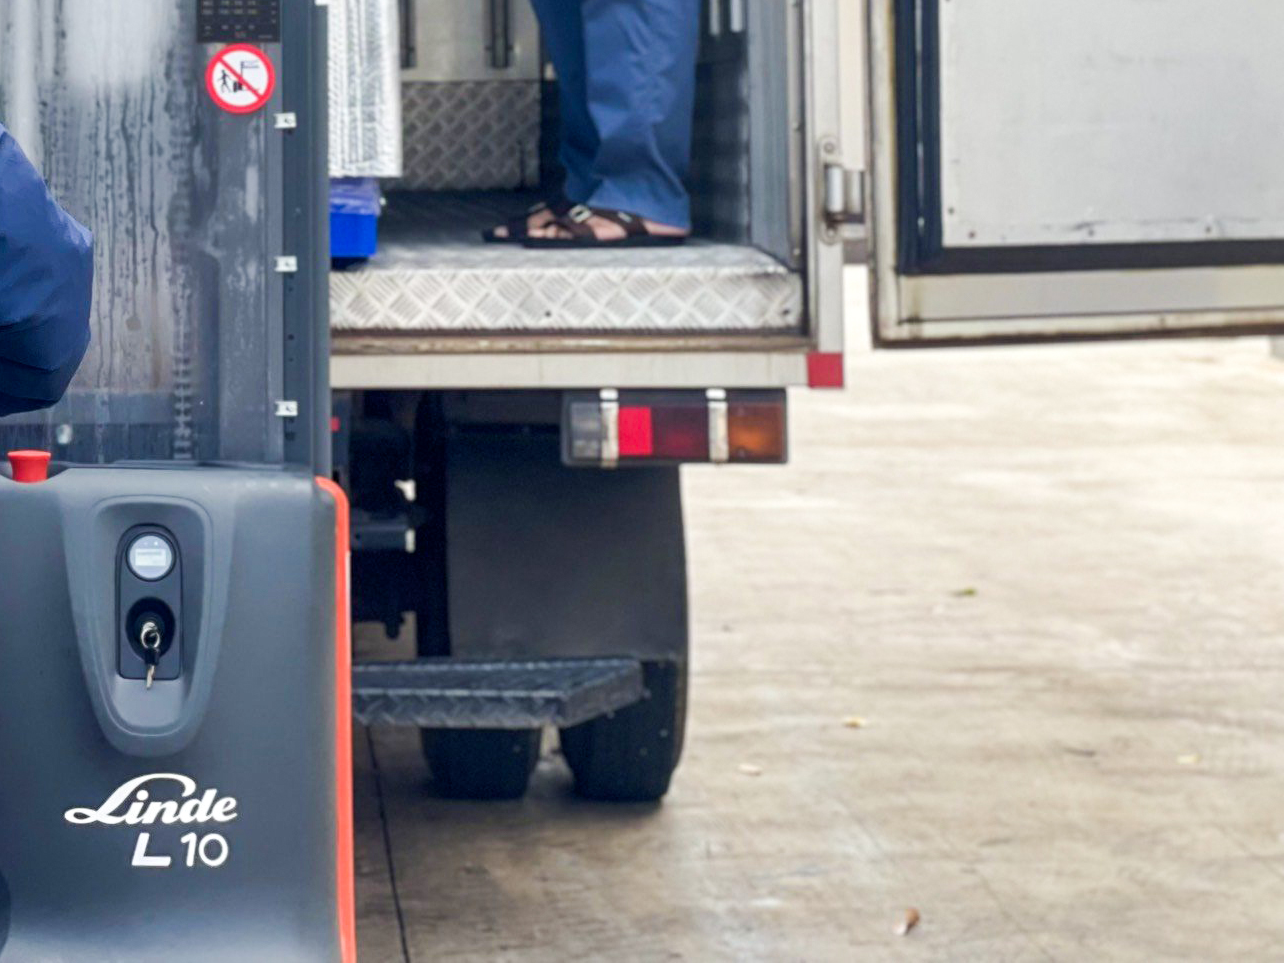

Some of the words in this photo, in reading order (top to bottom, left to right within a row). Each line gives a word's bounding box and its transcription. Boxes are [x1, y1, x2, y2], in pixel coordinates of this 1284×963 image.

[64, 772, 238, 825] Linde
[131, 832, 172, 867] L
[180, 832, 229, 867] 10
